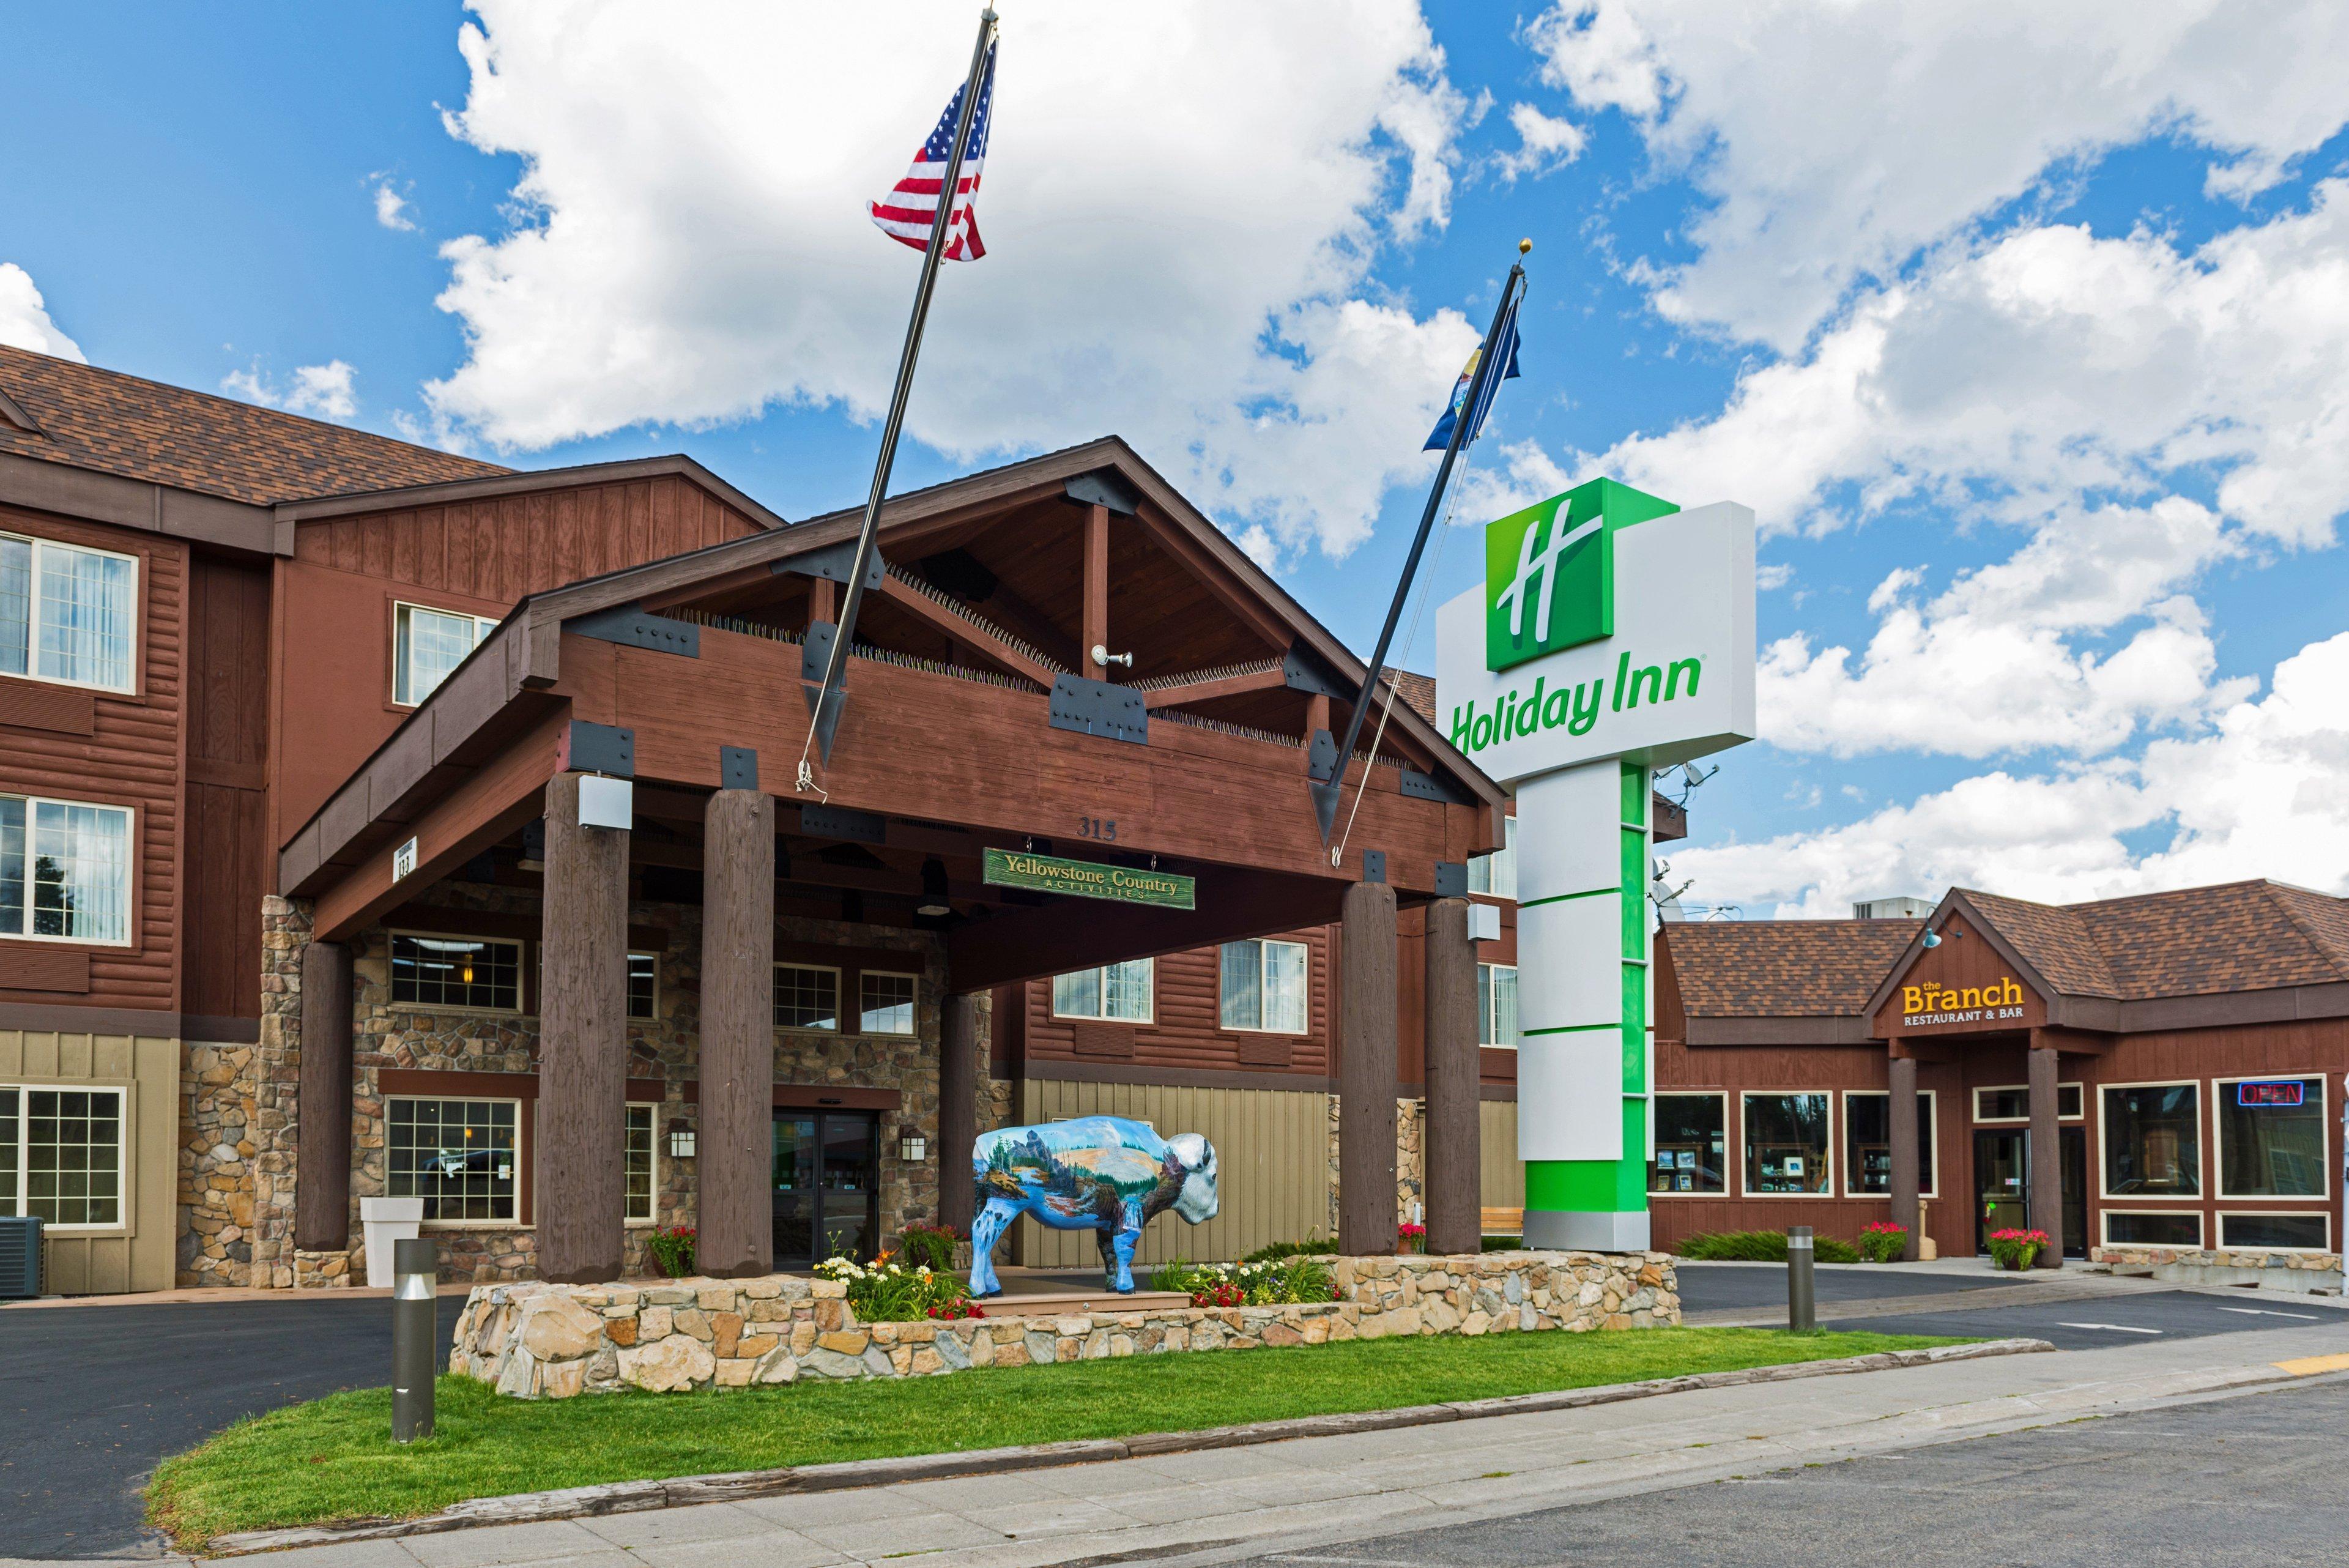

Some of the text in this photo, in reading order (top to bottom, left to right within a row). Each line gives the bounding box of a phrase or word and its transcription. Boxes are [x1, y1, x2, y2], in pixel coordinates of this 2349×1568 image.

[1449, 651, 1701, 756] Holiday Inn
[1077, 816, 1117, 841] 315
[1004, 855, 1179, 896] Yellowstone Country
[1046, 879, 1145, 899] ACTIVITIES
[1902, 977, 2025, 1014] Branch
[1923, 981, 1941, 991] the
[1904, 1007, 2024, 1026] RESTAURANT & BAR
[2241, 1085, 2301, 1103] OPEN
